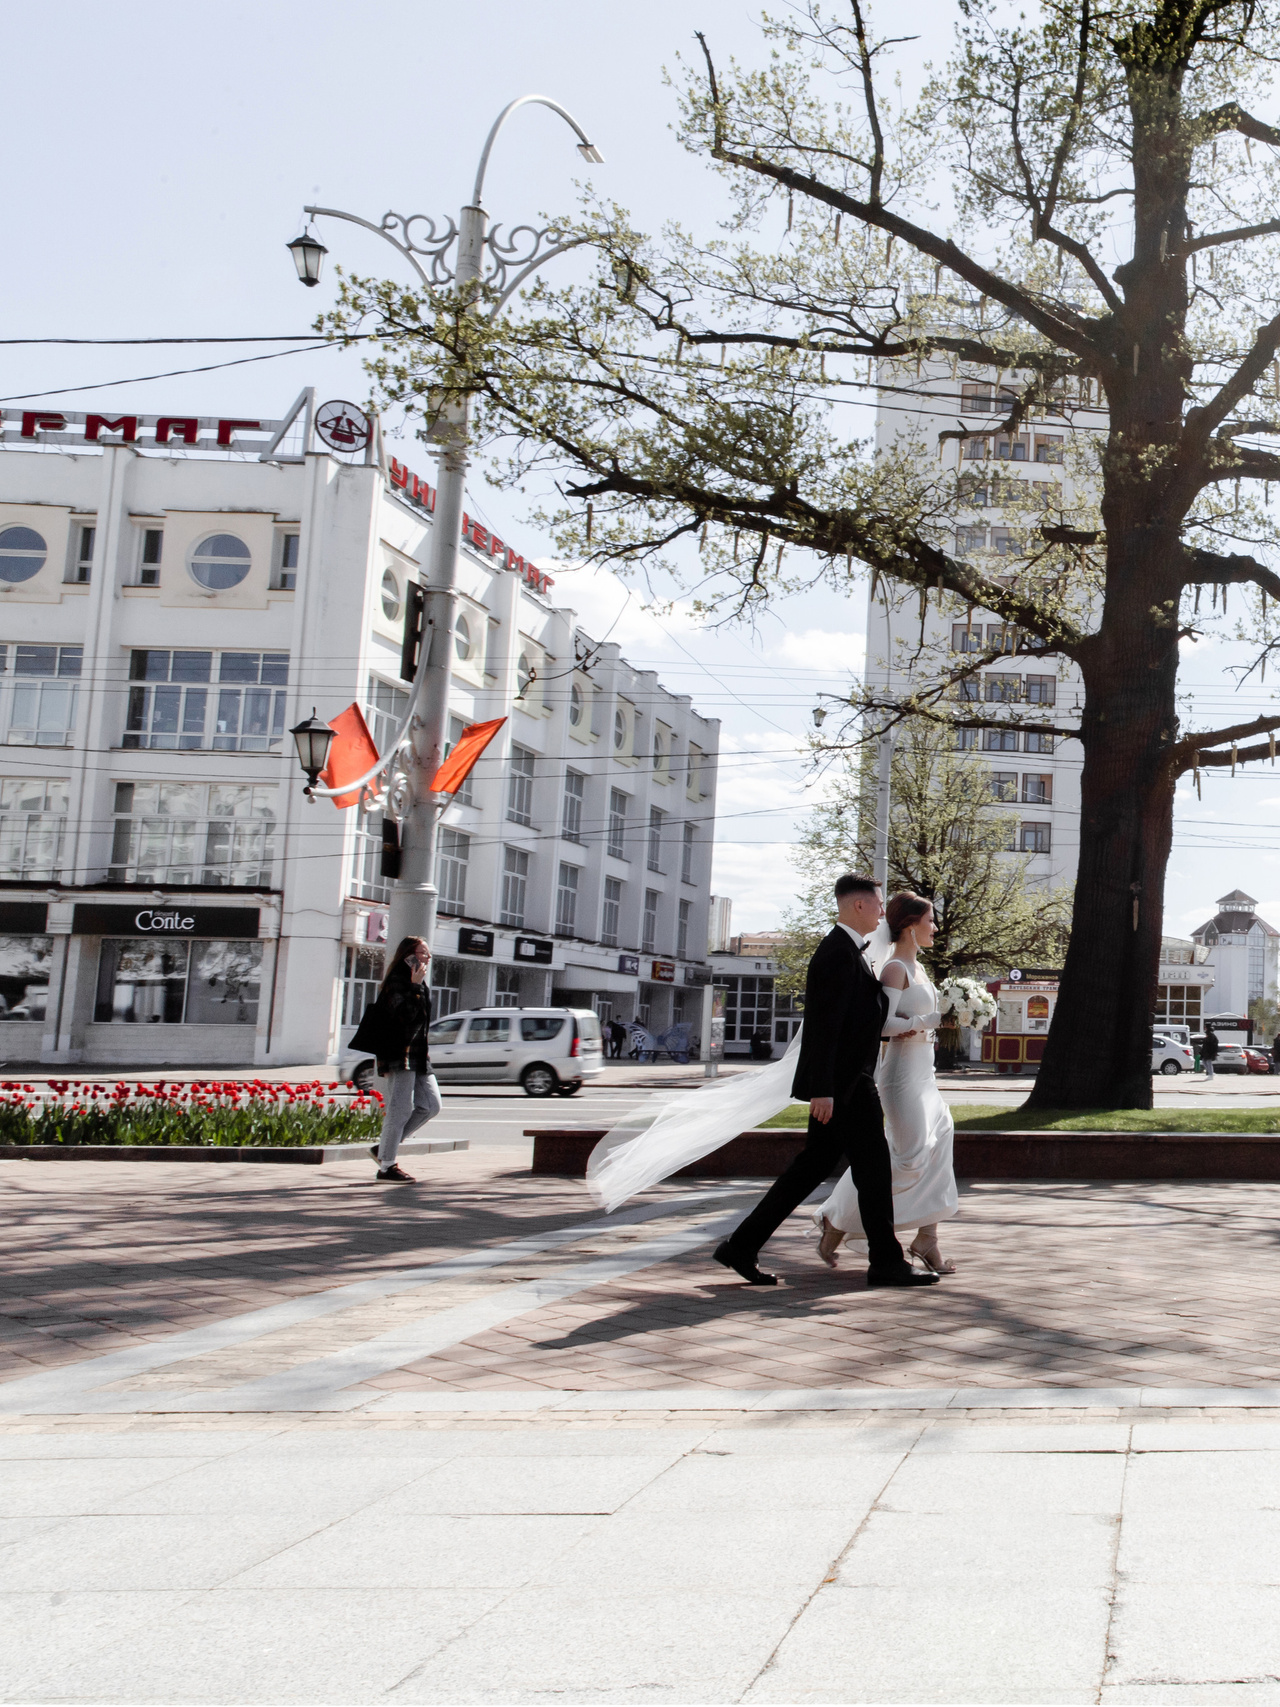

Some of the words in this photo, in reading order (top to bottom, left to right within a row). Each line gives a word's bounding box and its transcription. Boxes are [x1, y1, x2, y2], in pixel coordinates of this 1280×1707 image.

[0, 410, 261, 445] РМАГ
[390, 456, 555, 594] УНЕРМАГ
[135, 910, 195, 931] Conte
